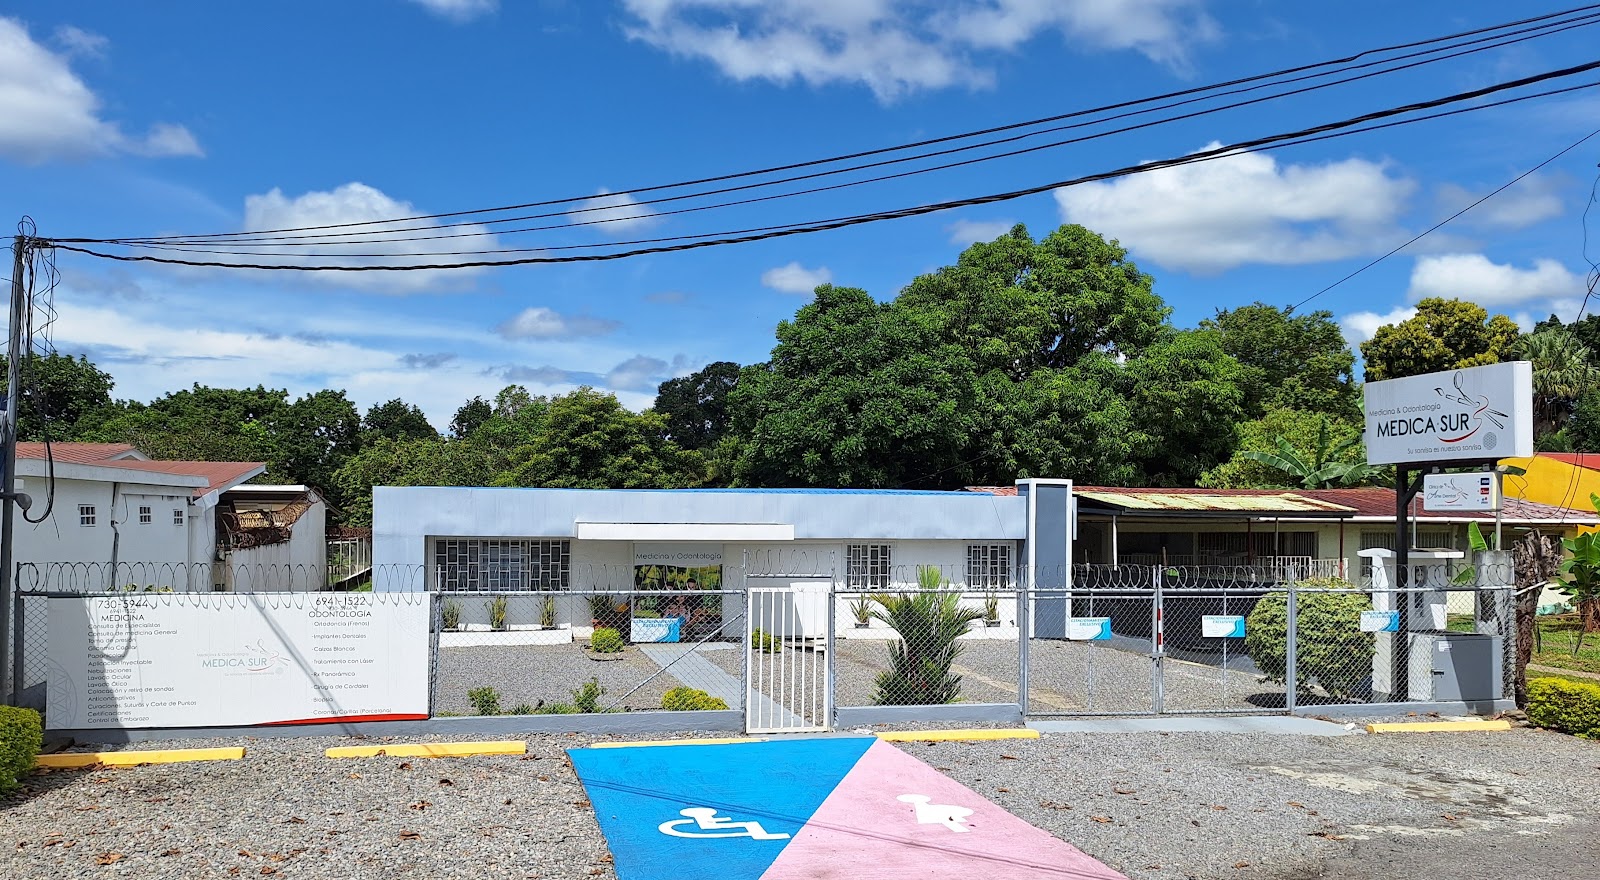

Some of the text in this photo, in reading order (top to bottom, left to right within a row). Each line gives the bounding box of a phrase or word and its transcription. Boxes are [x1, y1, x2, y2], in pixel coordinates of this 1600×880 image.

[1369, 408, 1396, 417] Medicina
[1377, 413, 1469, 438] MEDICA SUR
[98, 600, 148, 608] 730-5944
[316, 596, 366, 606] 6941-1522
[202, 658, 268, 668] MEDICA SUR
